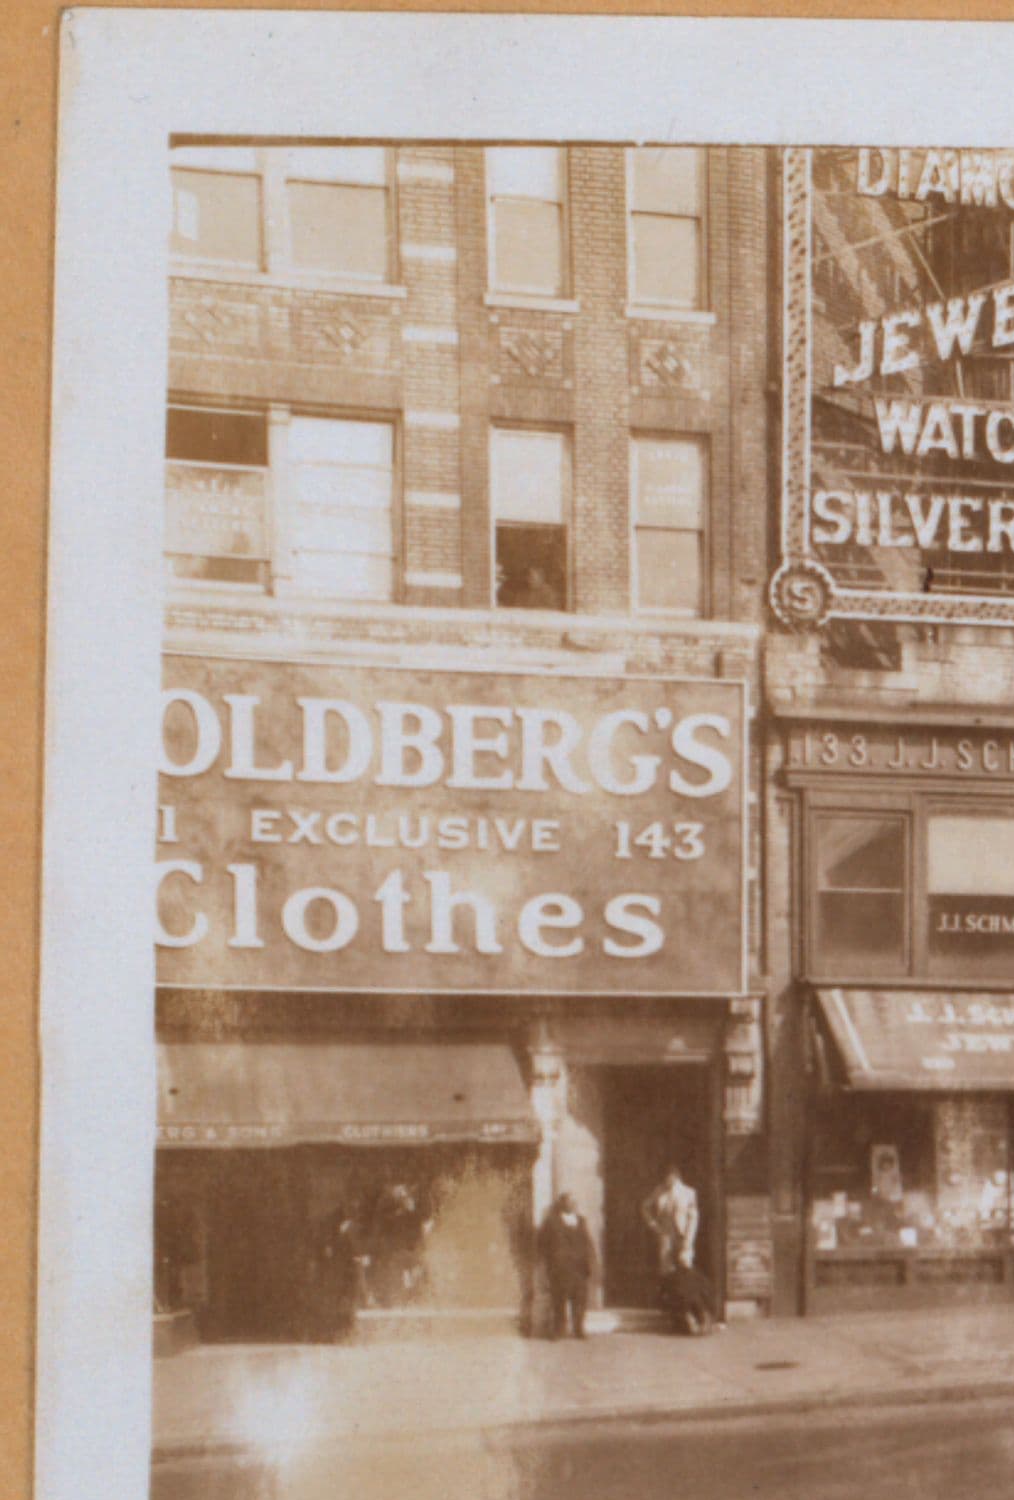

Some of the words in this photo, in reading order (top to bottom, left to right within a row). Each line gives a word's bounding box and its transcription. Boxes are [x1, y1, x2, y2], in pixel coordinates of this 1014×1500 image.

[804, 733, 868, 767] 133
[250, 808, 562, 852] EXCLUSIVE
[614, 821, 706, 860] 143
[154, 860, 666, 958] Clothes
